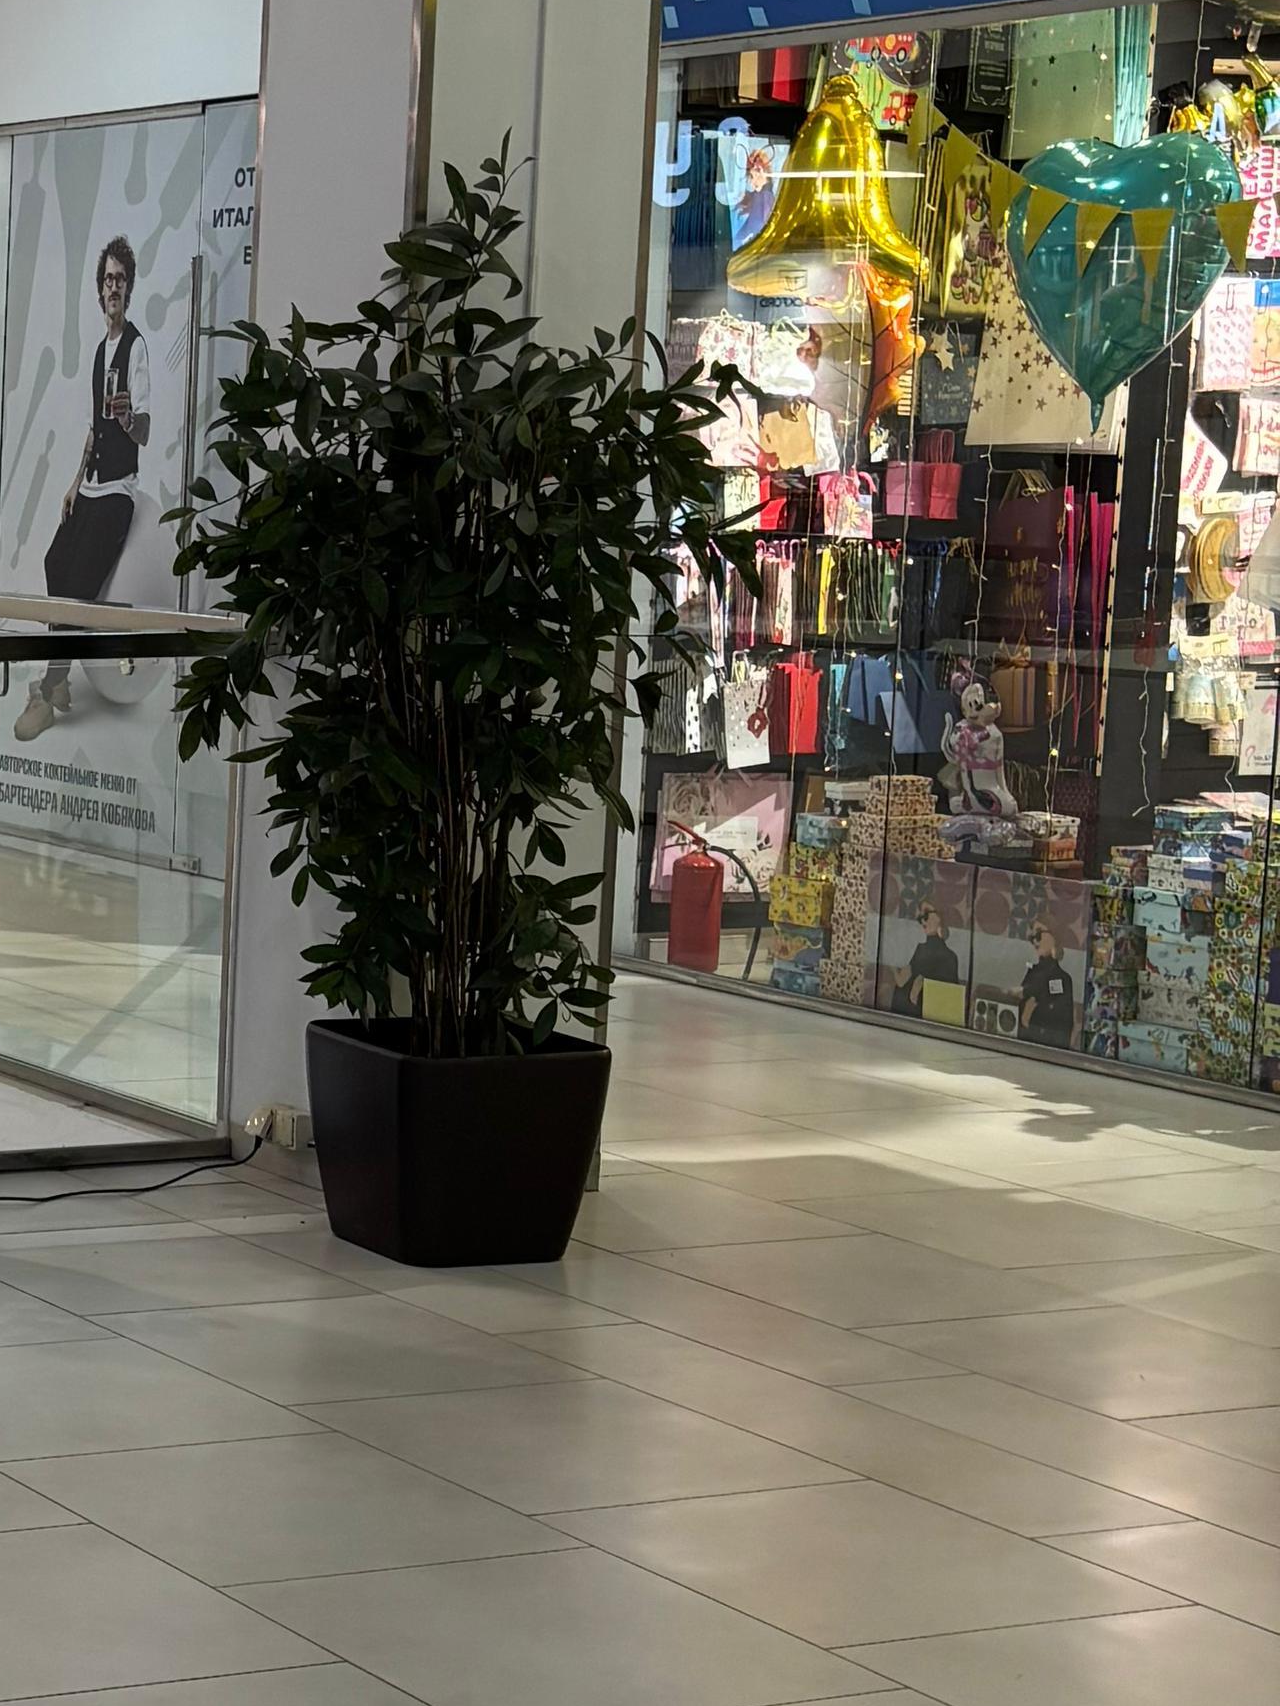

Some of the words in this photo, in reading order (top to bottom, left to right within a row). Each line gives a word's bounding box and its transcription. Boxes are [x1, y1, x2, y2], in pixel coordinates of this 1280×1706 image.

[43, 762, 100, 789] КОКТЕЙЛЬНОЕ
[100, 772, 126, 794] МЕНЮ
[125, 777, 138, 796] ОТ
[59, 793, 100, 823] АНДРЕЯ
[100, 801, 157, 834] КОБЯКОВА
